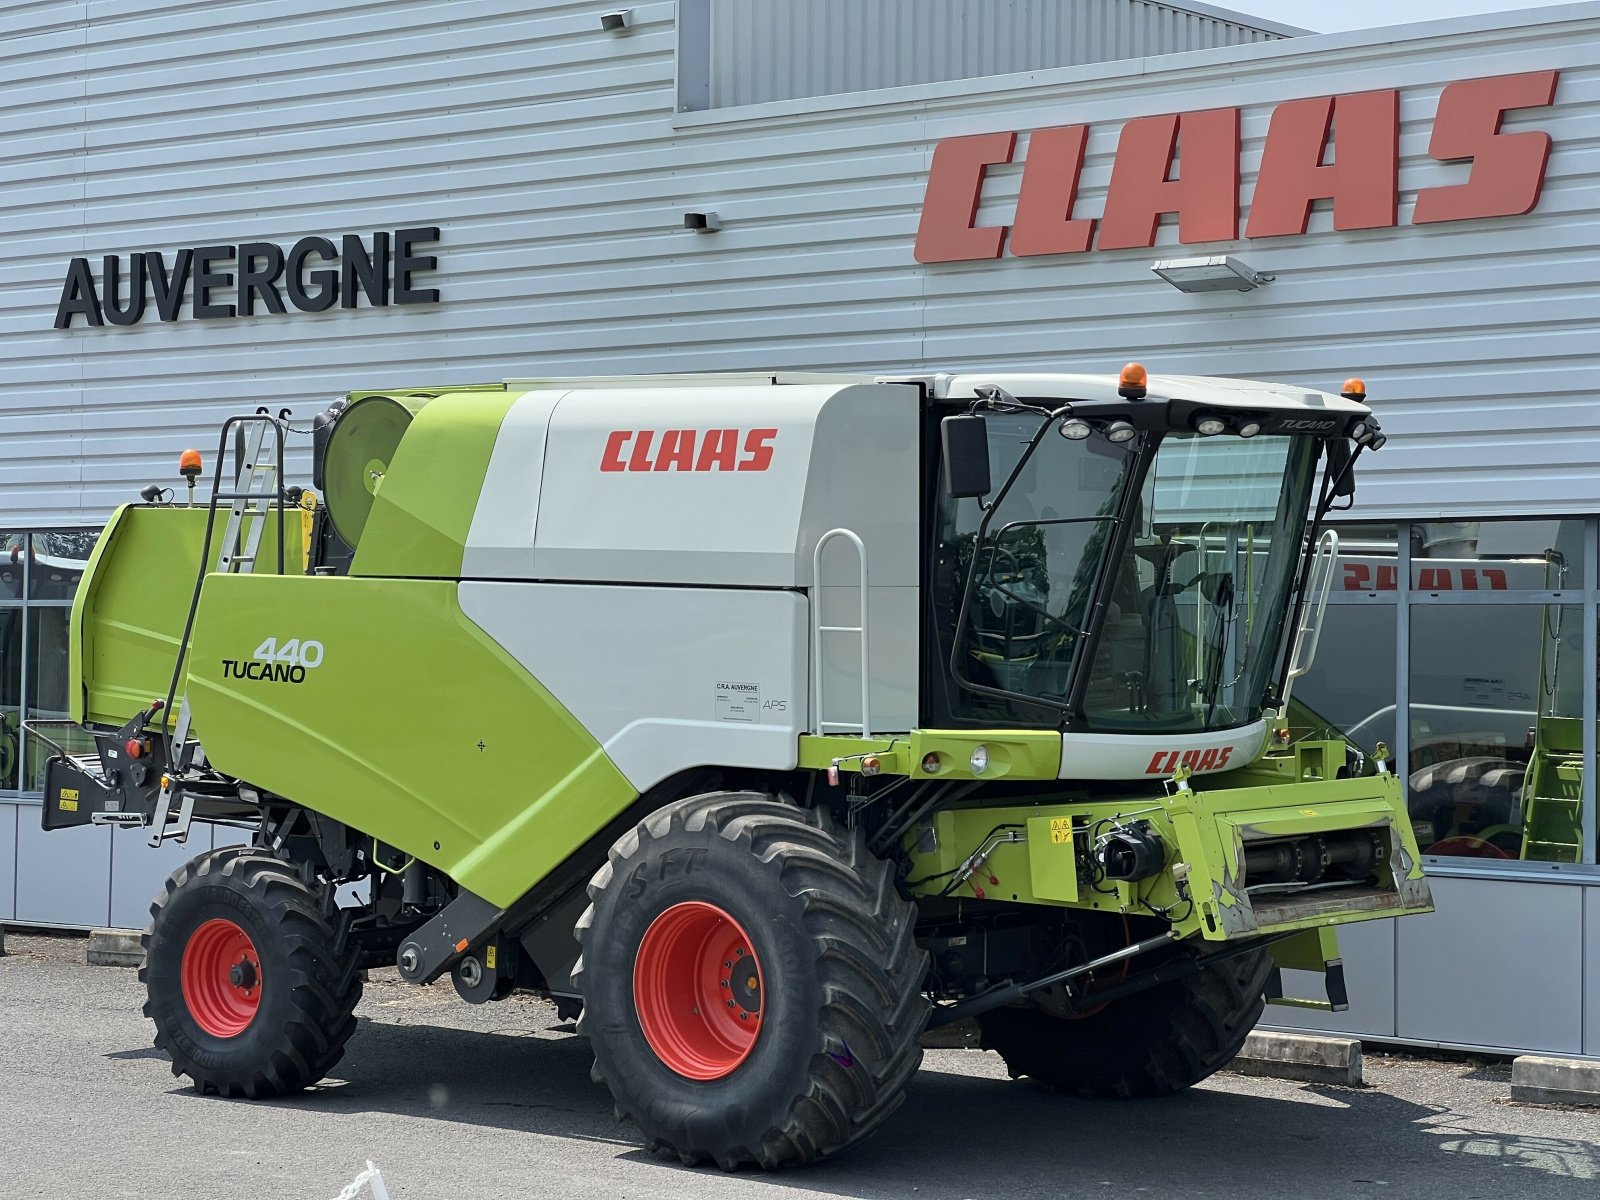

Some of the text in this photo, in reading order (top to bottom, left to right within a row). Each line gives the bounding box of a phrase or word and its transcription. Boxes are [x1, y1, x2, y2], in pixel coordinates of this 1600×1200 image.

[914, 70, 1559, 263] CLAAS
[54, 227, 440, 329] AUVERGNE
[1279, 419, 1336, 430] TUCANO
[600, 428, 778, 472] CLAAS
[253, 637, 324, 668] 440
[222, 660, 306, 684] TUCANO
[762, 699, 788, 711] APS
[1145, 746, 1234, 774] CLAAS
